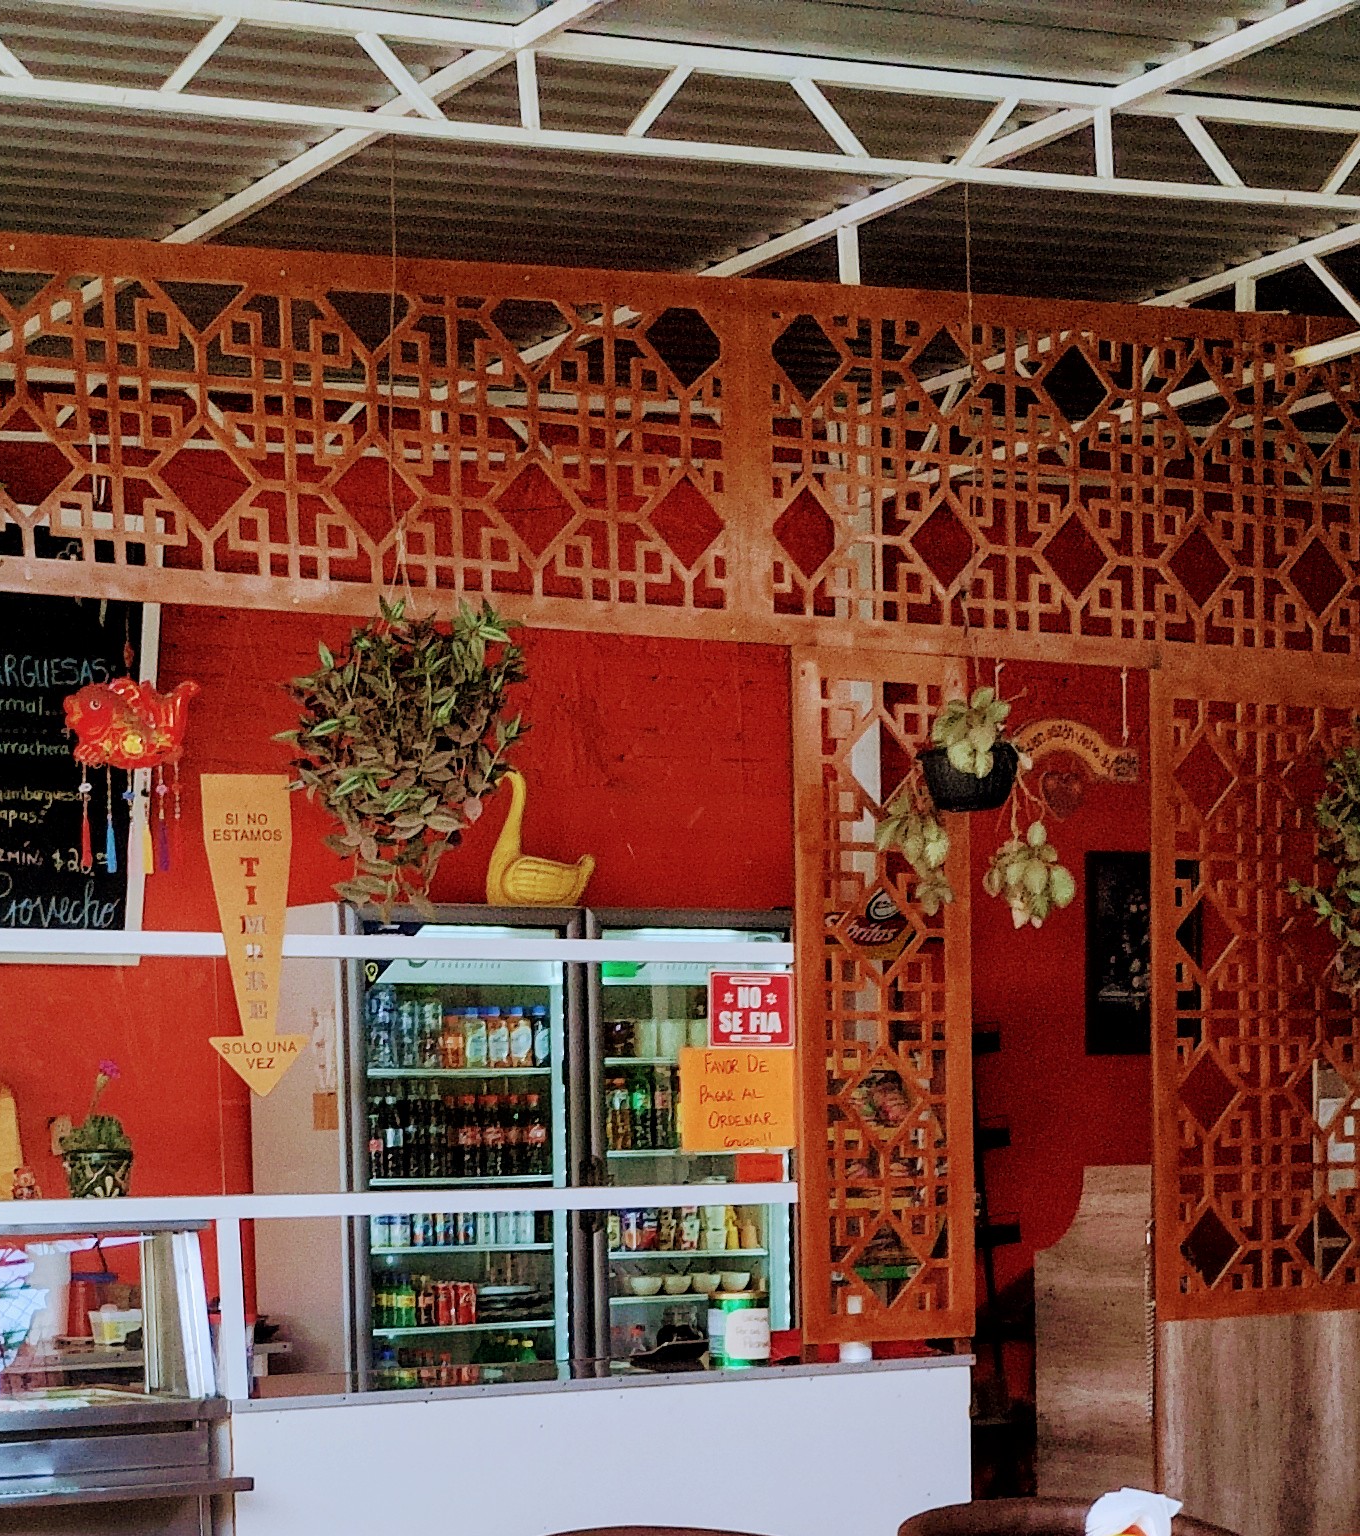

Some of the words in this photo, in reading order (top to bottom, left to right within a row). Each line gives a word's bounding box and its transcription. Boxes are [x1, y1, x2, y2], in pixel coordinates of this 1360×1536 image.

[225, 813, 239, 826] SI
[246, 813, 268, 826] NO
[212, 828, 282, 842] ESTAMOS
[737, 986, 762, 1009] NO
[718, 1010, 744, 1033] SE
[749, 1011, 783, 1034] FIA
[221, 1042, 262, 1055] SOLO
[267, 1041, 297, 1054] UNA
[246, 1058, 275, 1069] VEZ
